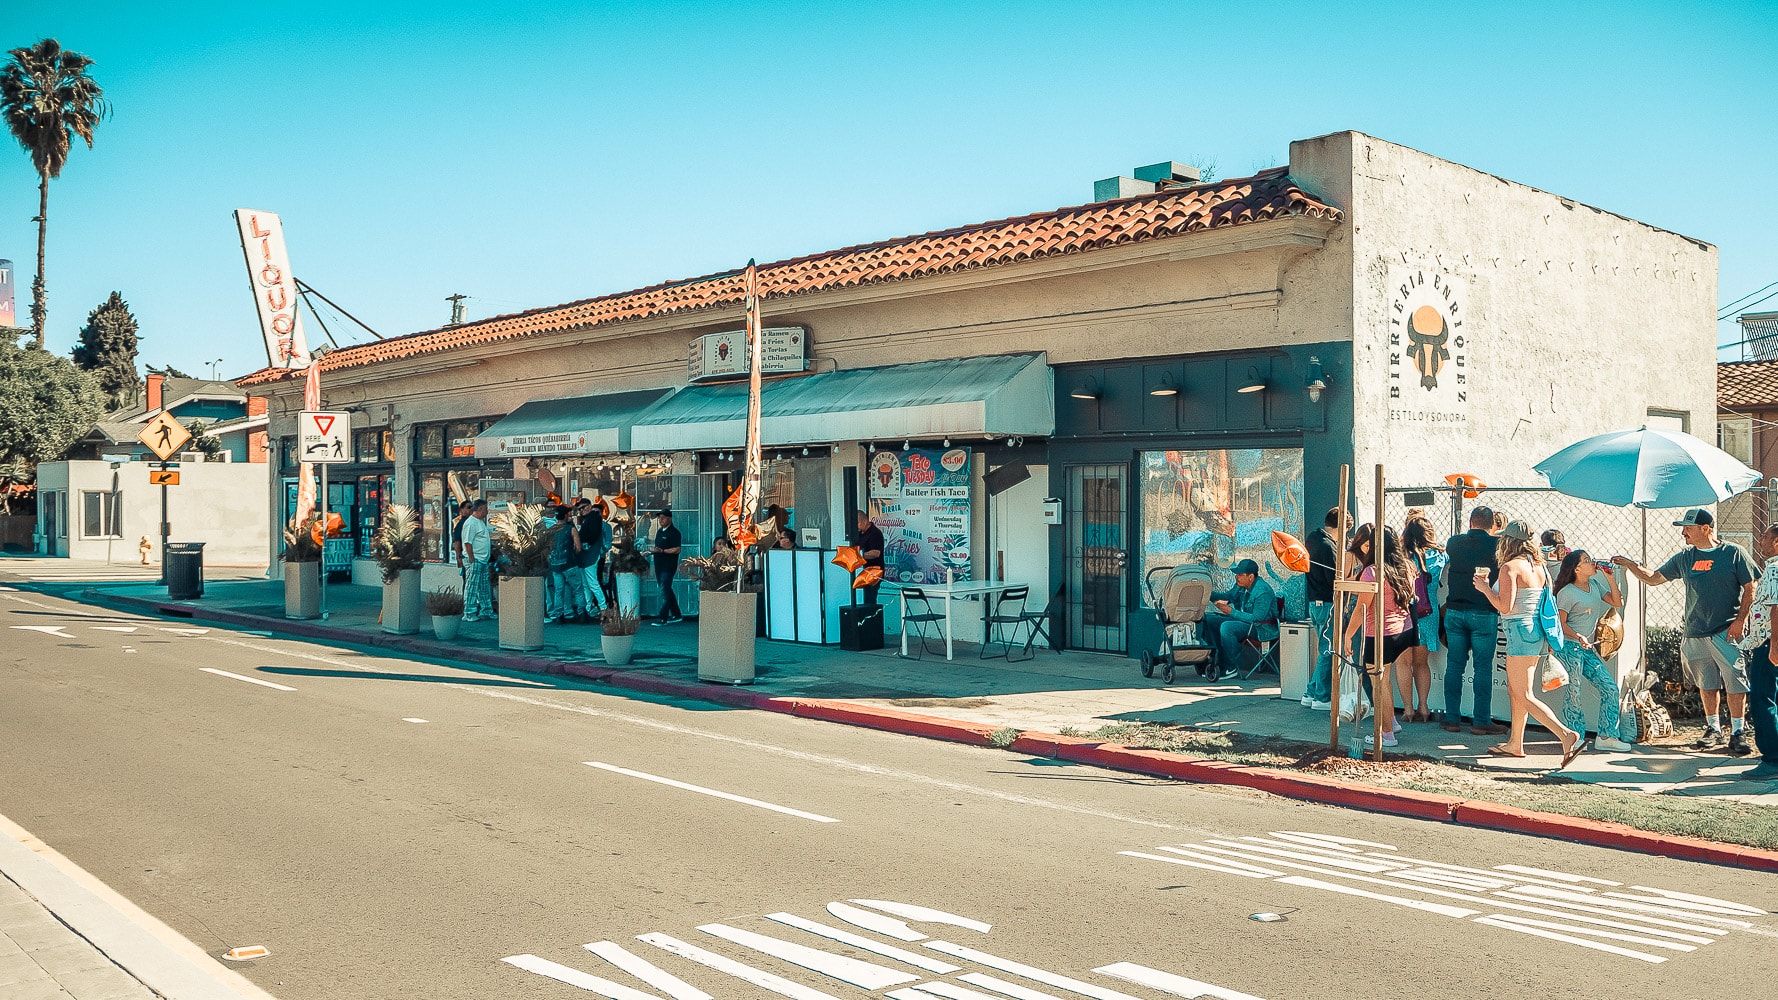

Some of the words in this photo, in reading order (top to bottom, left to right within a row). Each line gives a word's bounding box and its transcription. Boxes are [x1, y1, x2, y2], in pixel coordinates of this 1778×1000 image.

[250, 214, 300, 361] LIQUOR
[1390, 270, 1424, 399] BIRRIERIA
[1434, 274, 1467, 402] ENRIQUEZ
[1391, 409, 1424, 421] ESTILO
[1431, 411, 1466, 423] SONORA
[909, 453, 930, 471] Taco
[943, 456, 963, 465] $3.00
[930, 488, 946, 496] Fish
[948, 488, 966, 496] Taco
[903, 529, 922, 540] BIRRIA
[897, 539, 921, 554] Fries
[1691, 559, 1715, 571] NIKE
